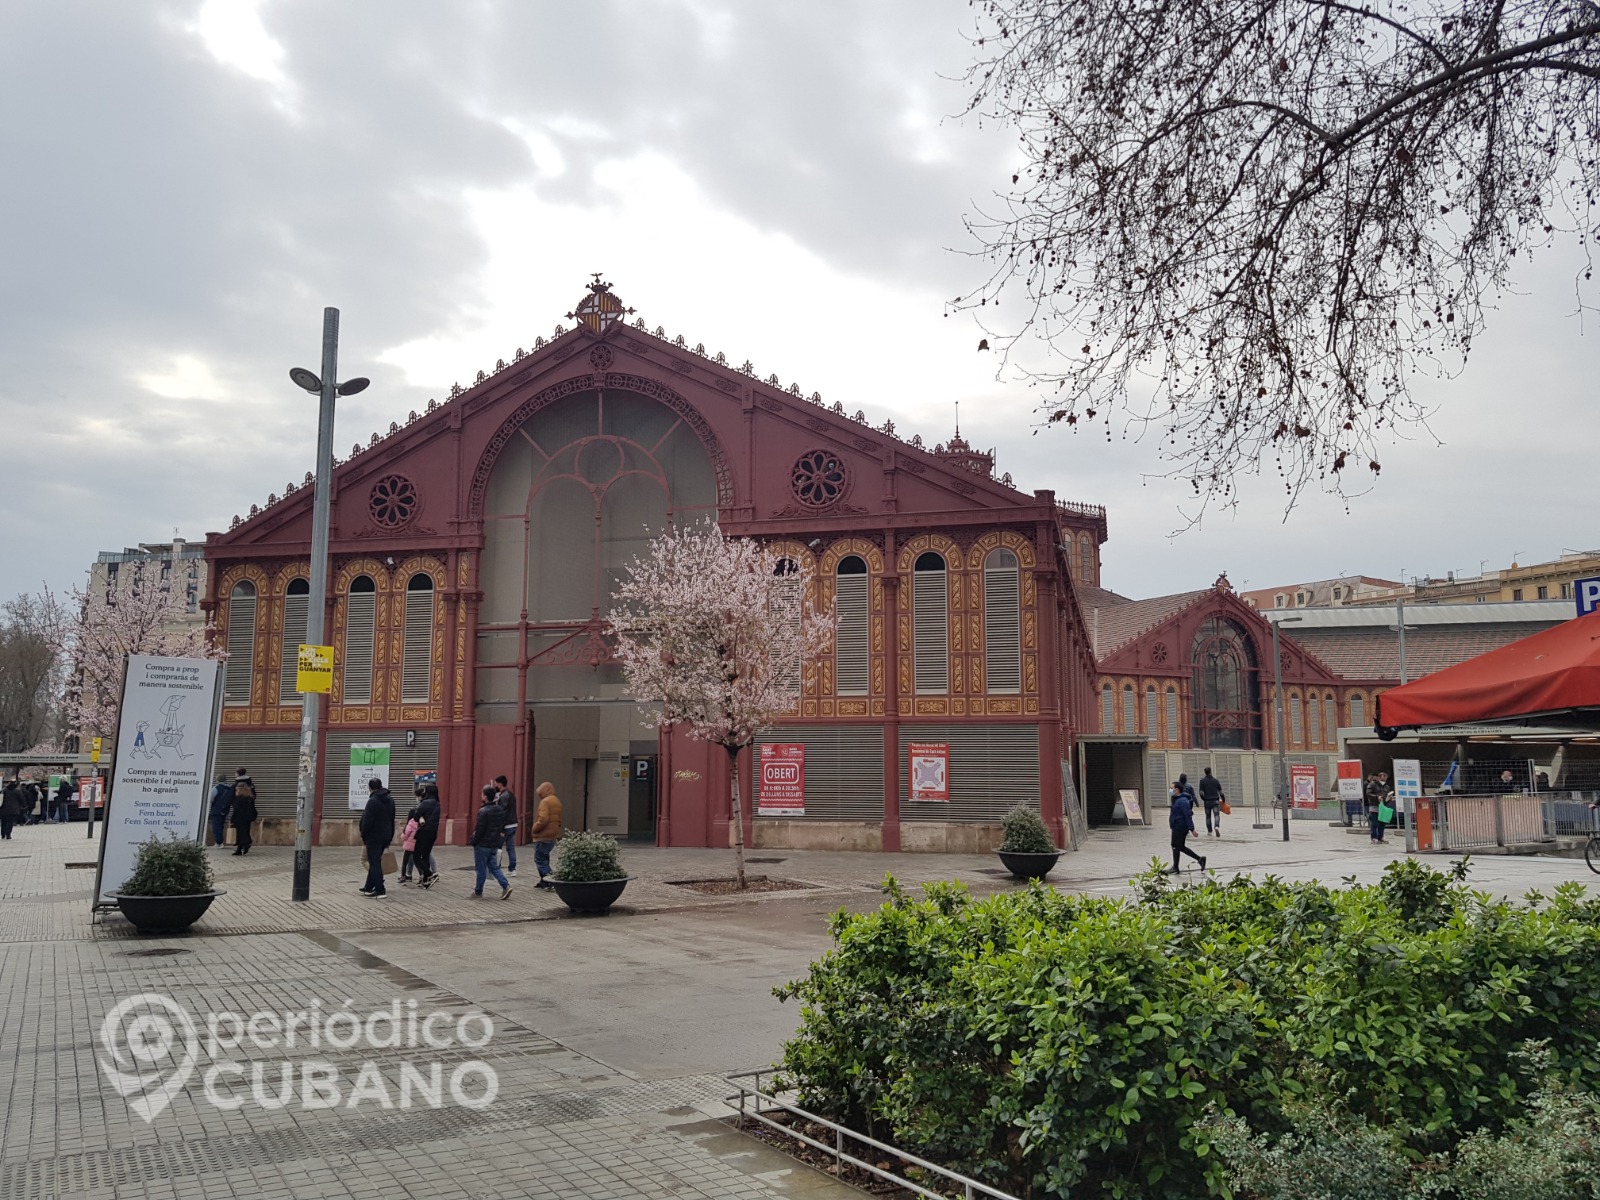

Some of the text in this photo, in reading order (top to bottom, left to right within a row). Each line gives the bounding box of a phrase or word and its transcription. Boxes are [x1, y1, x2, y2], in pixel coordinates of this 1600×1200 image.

[1581, 580, 1600, 612] P
[145, 663, 174, 672] Compra
[128, 768, 156, 776] Compra
[637, 761, 648, 776] P
[767, 768, 795, 779] OBERT
